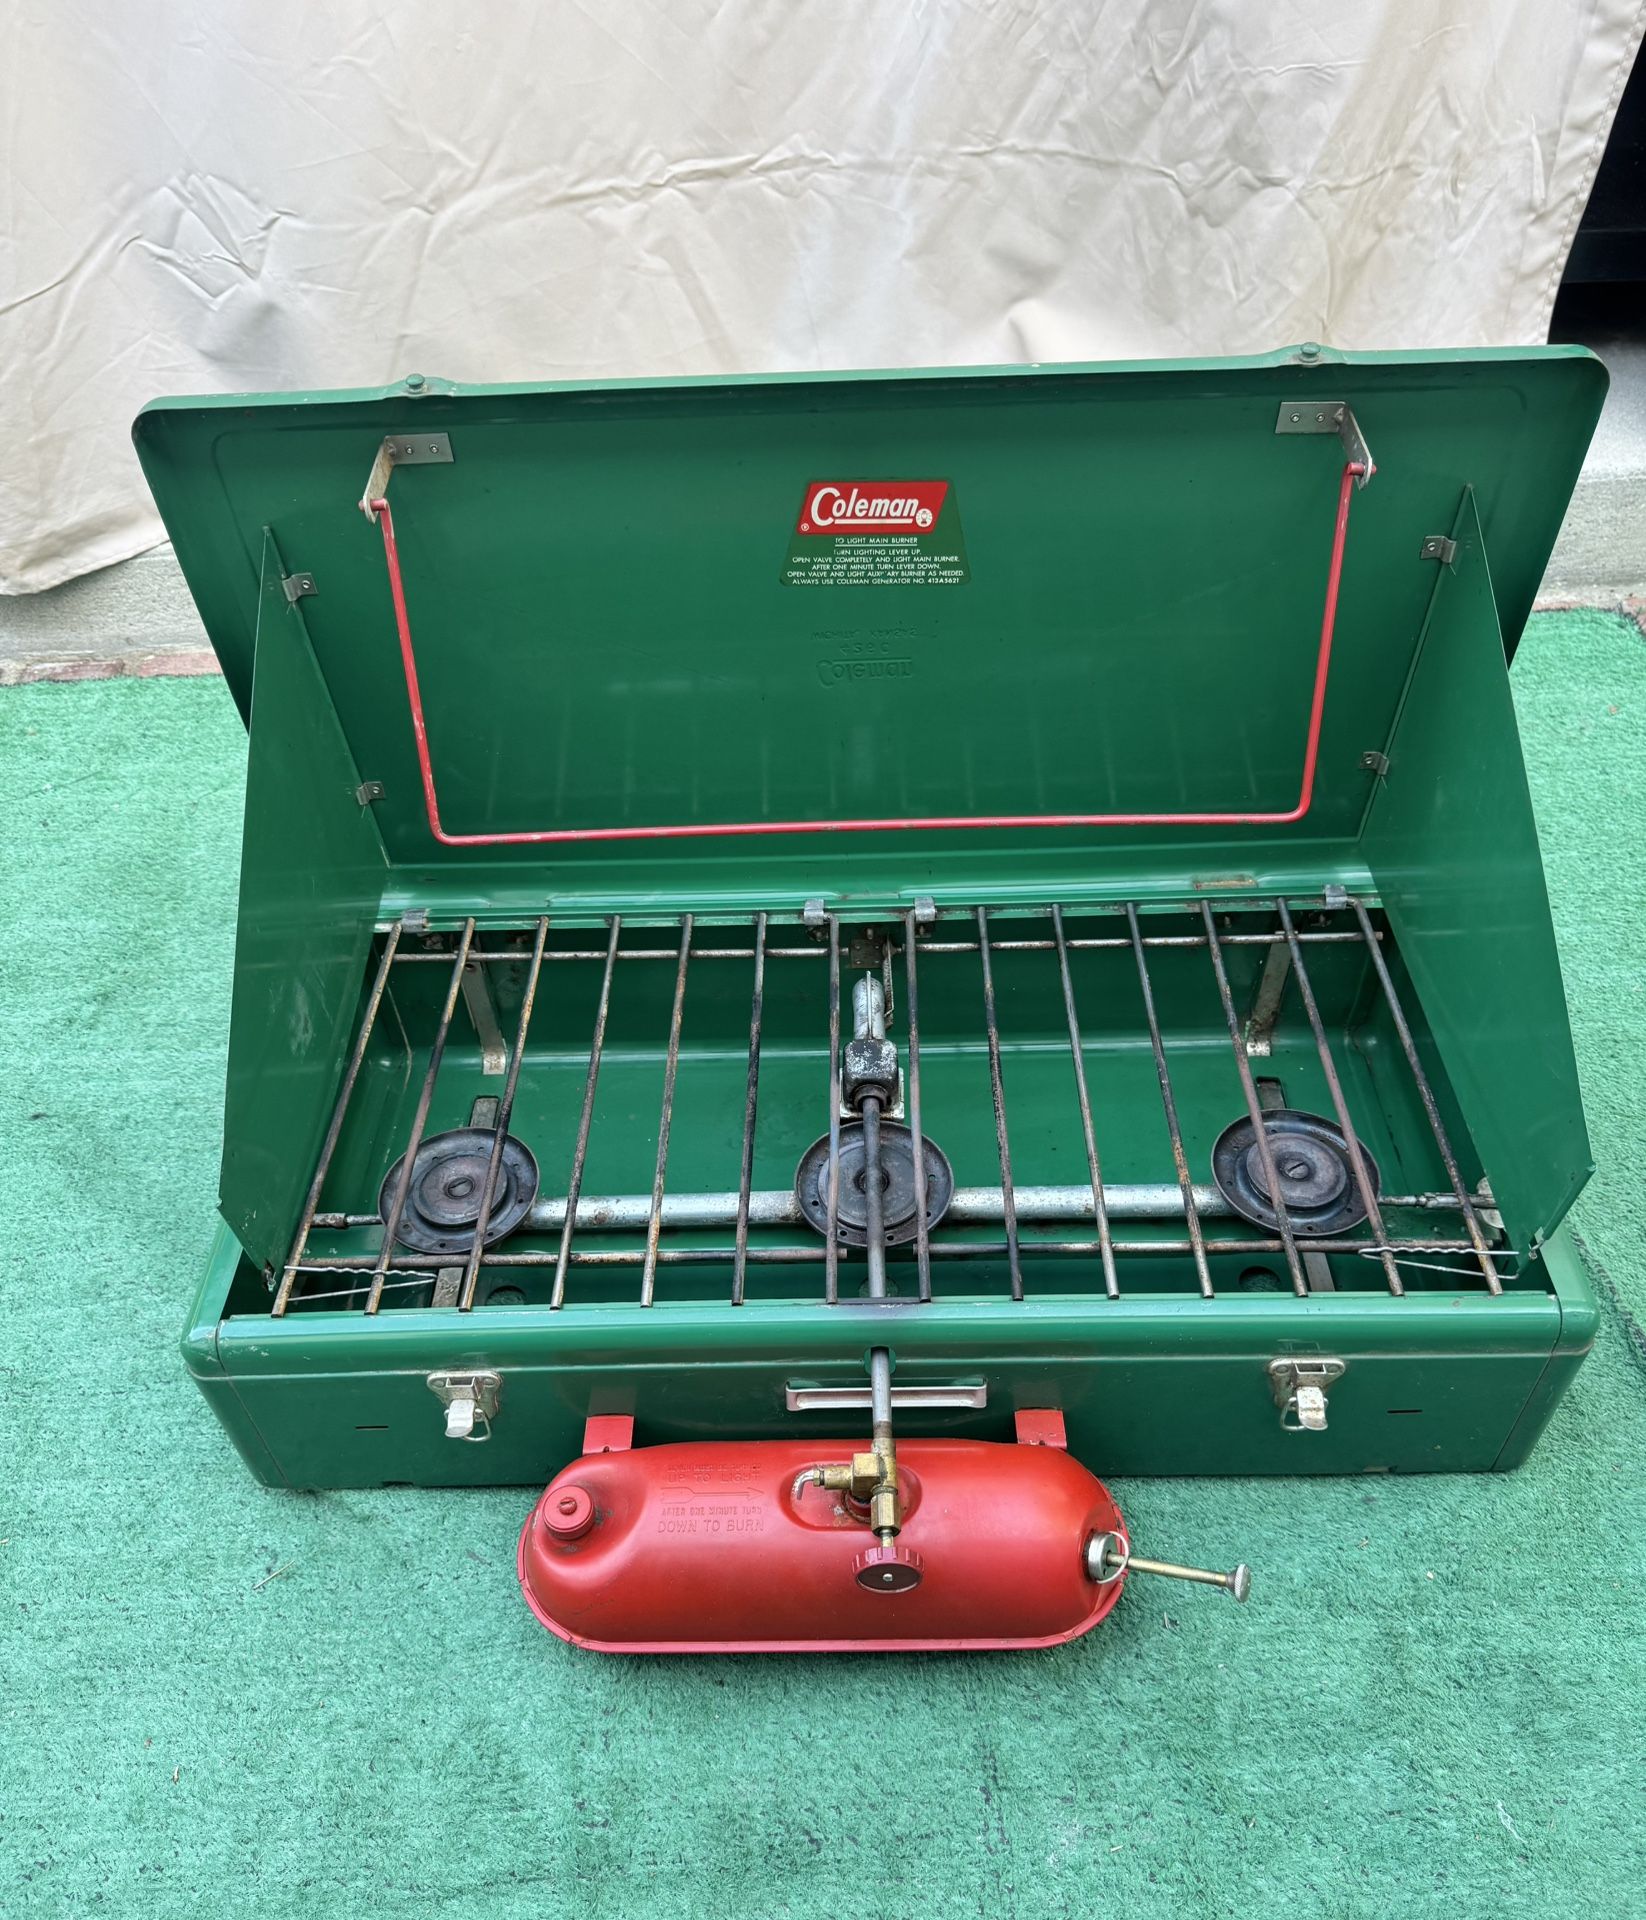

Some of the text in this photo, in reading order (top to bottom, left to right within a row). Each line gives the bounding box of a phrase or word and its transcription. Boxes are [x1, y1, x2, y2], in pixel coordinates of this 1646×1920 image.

[811, 487, 919, 527] Coleman
[658, 1519, 764, 1533] DOWN TO BURN
